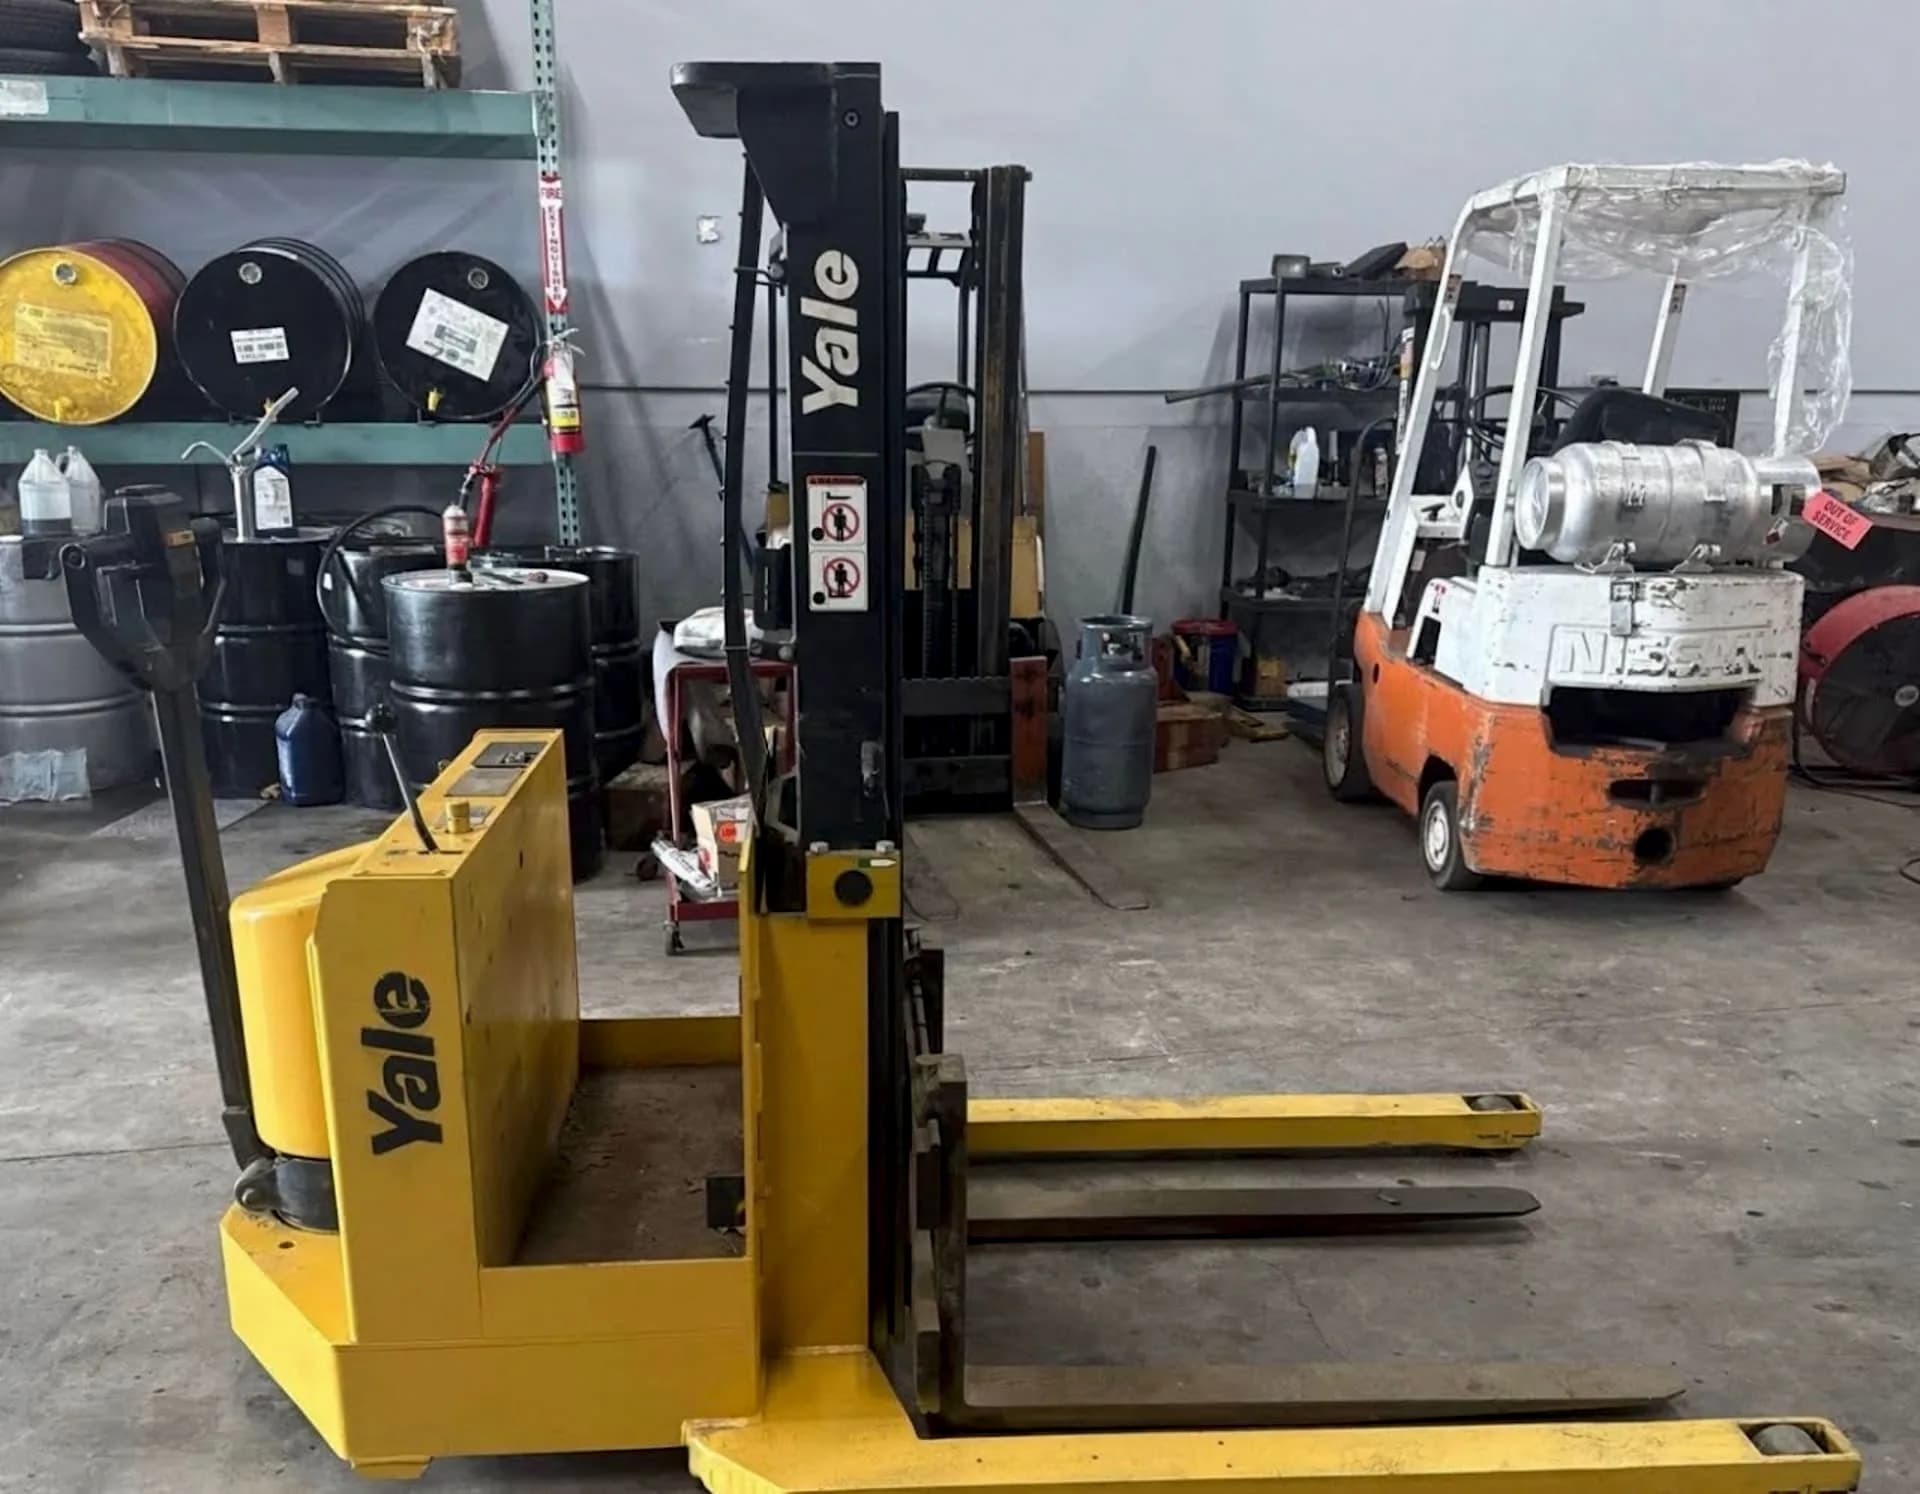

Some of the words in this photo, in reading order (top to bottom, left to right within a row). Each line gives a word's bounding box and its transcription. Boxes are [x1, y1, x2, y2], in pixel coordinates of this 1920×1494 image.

[541, 188, 564, 199] FIRE
[800, 249, 859, 415] Yale
[1812, 511, 1853, 541] SERVICE
[1824, 501, 1845, 519] OUT
[1842, 513, 1859, 526] OF
[361, 971, 443, 1155] Yale
